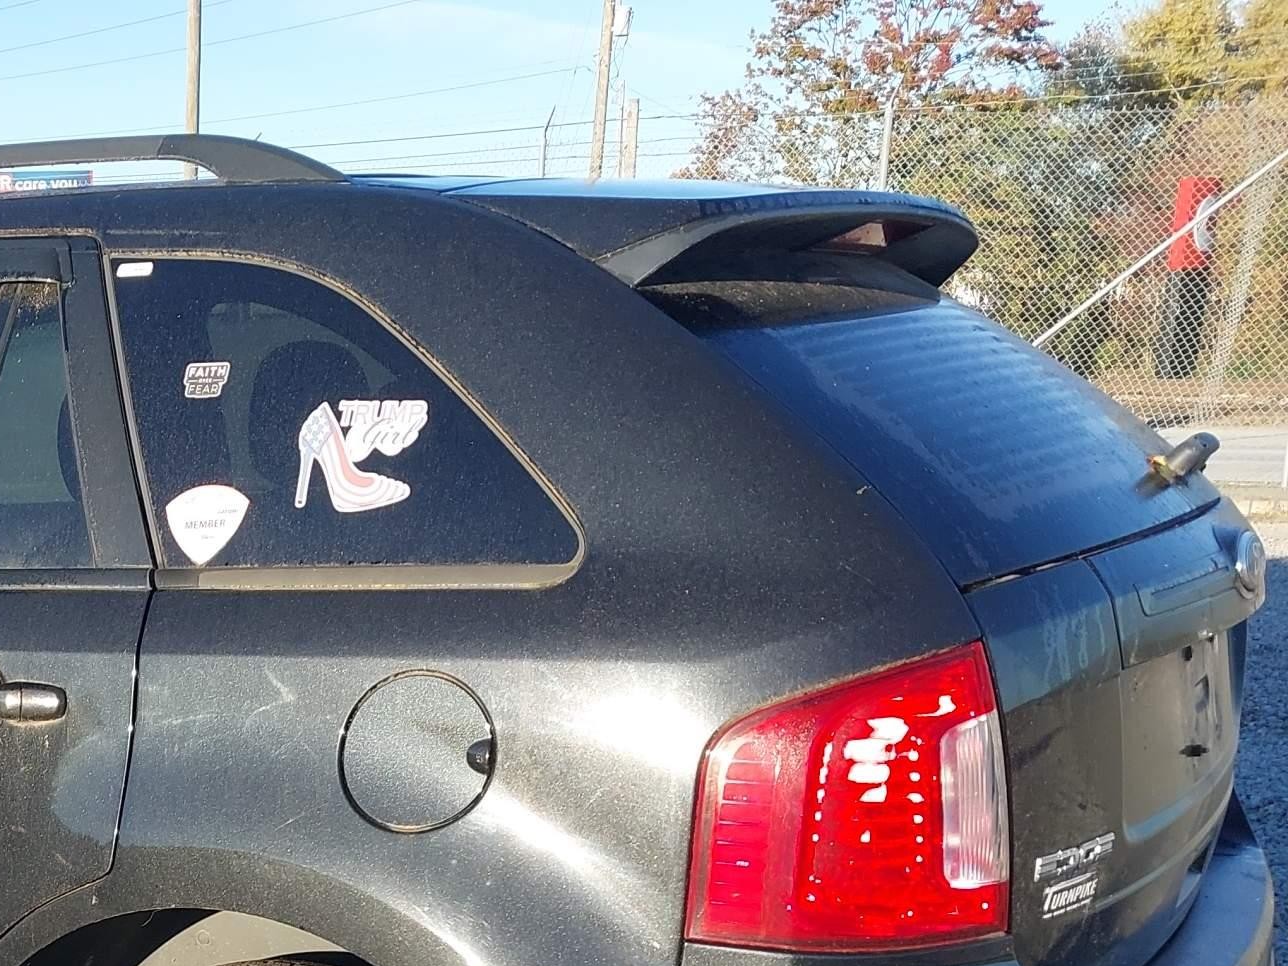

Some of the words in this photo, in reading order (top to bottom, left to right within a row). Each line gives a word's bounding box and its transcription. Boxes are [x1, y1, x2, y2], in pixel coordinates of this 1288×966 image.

[188, 366, 227, 377] FAITH
[188, 384, 219, 395] FEAR
[340, 402, 426, 425] TRUMP
[362, 416, 424, 451] Girl
[184, 519, 226, 530] MEMBER
